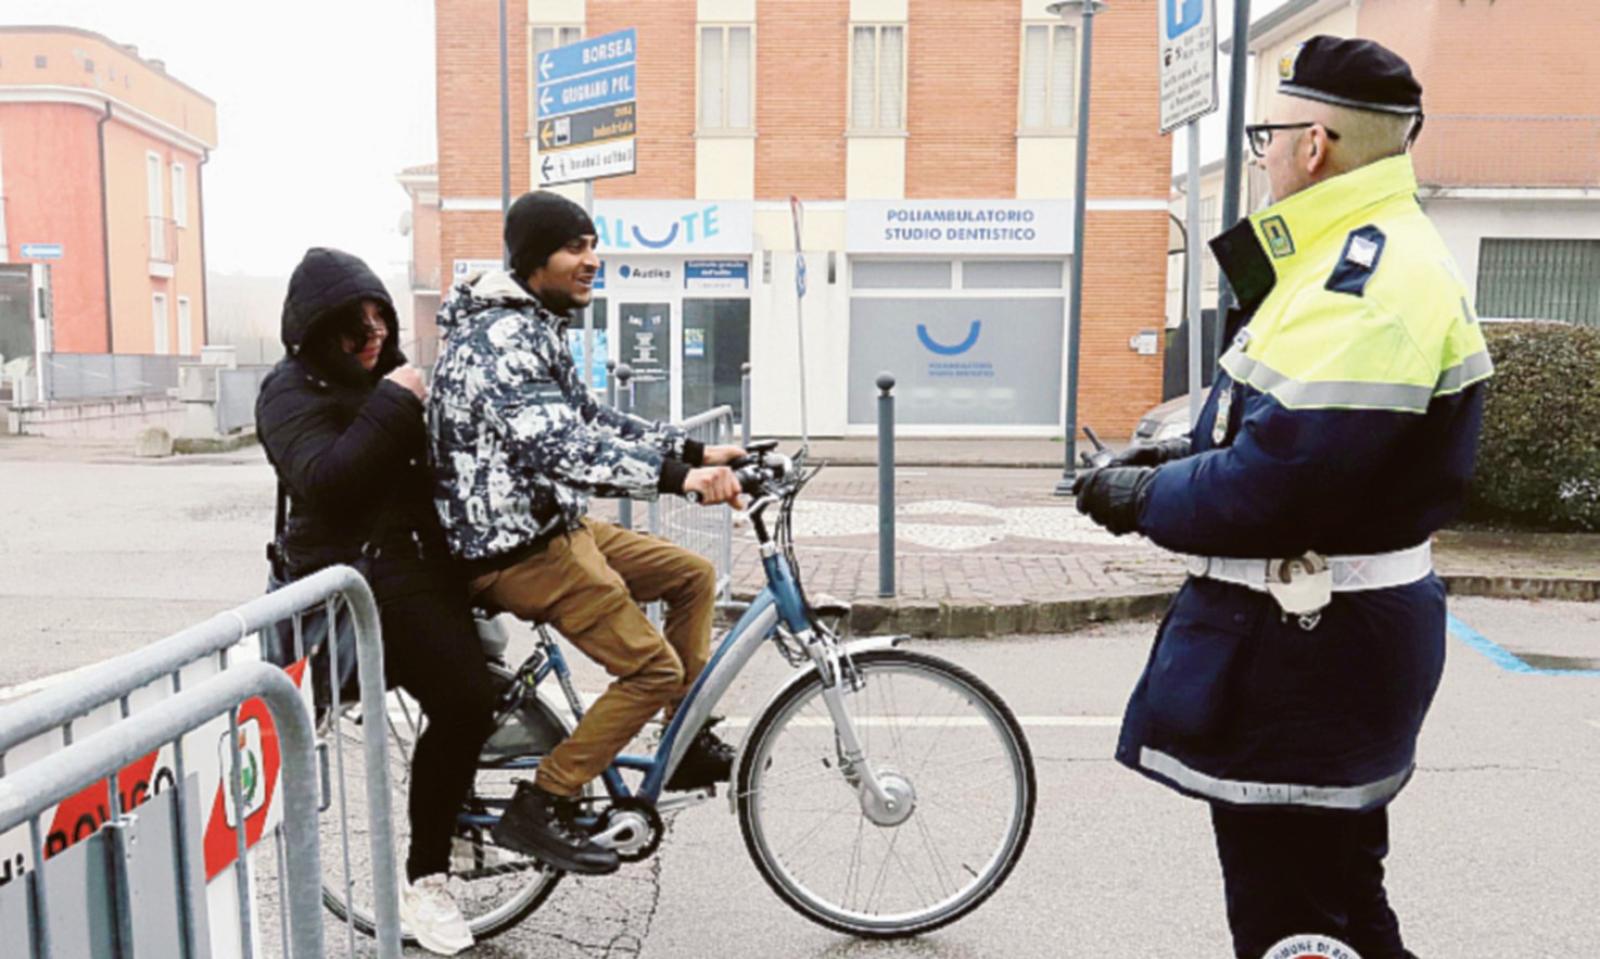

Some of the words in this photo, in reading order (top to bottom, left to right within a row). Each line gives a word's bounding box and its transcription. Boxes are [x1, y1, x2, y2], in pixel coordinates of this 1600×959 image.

[582, 38, 632, 64] BORSEA
[594, 203, 719, 249] ALUTE
[886, 209, 1035, 223] POLIAMBULATORIO
[884, 227, 942, 241] STUDIO
[946, 227, 1036, 241] DENTISTICO
